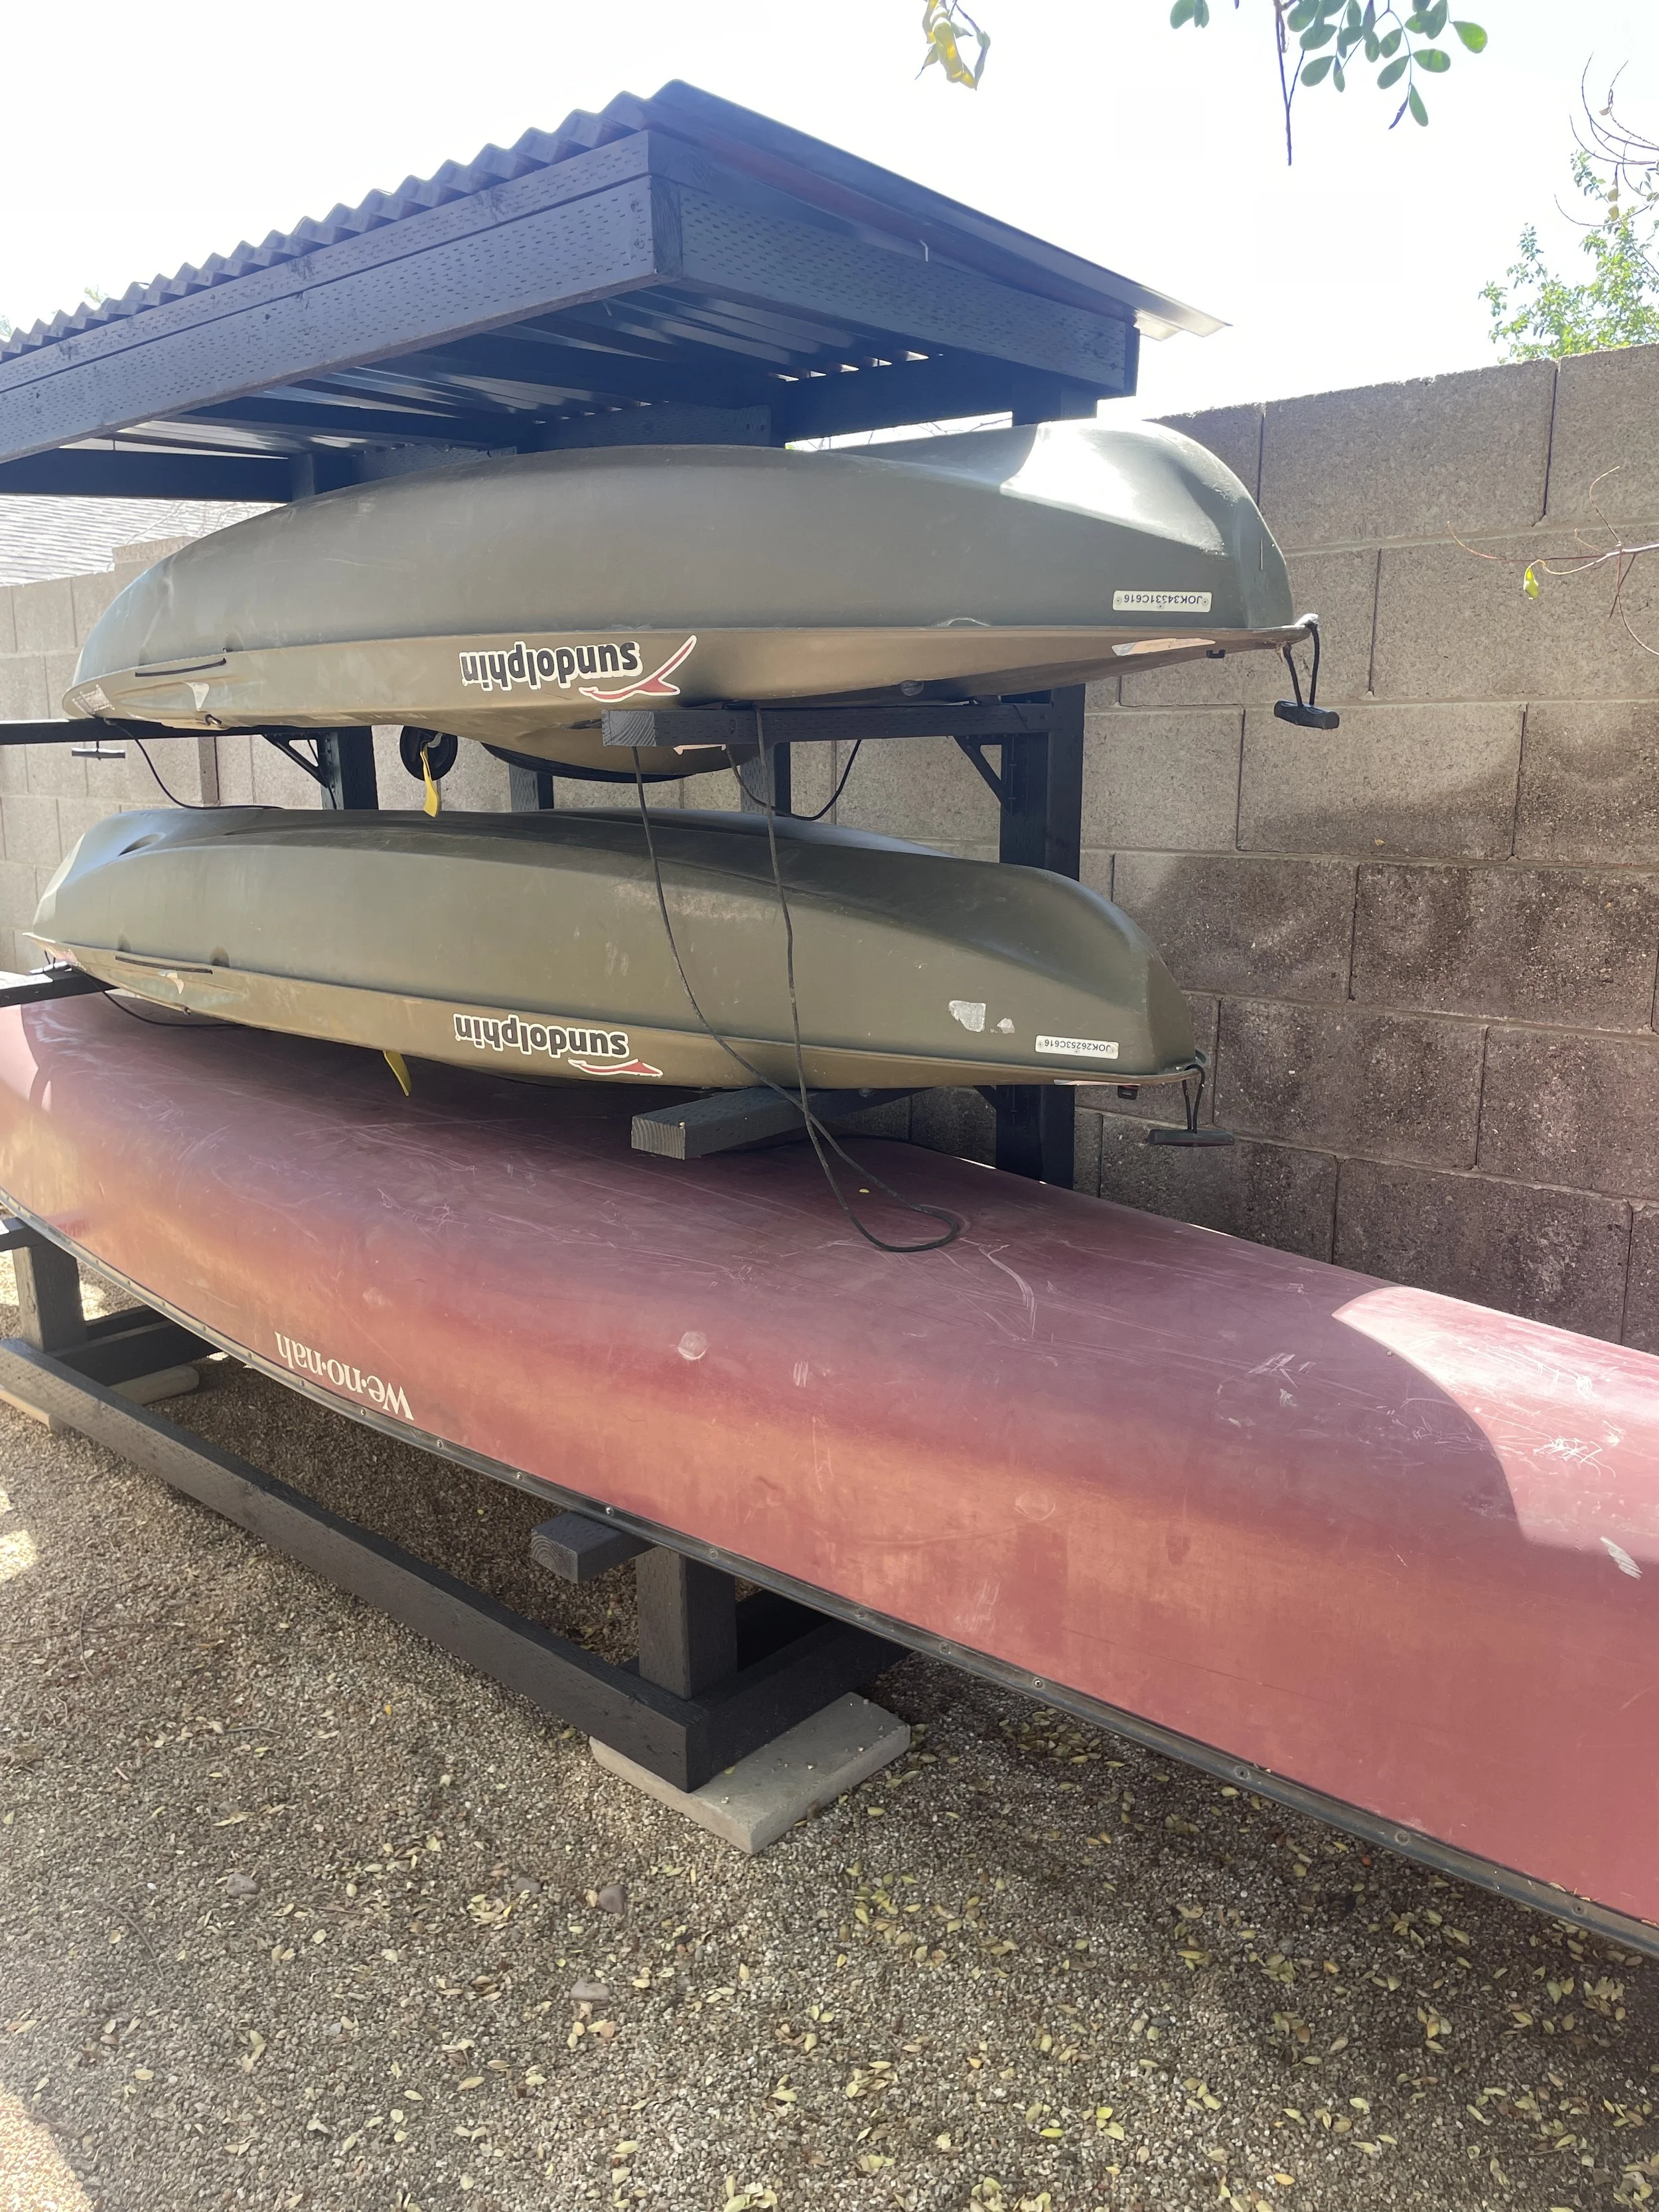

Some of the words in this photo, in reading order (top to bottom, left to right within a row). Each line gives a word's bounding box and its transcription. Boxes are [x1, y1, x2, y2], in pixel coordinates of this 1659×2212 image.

[461, 641, 639, 689] sundolphin
[455, 1015, 628, 1056] sundolphin
[1045, 1039, 1111, 1051] JOK26253C616
